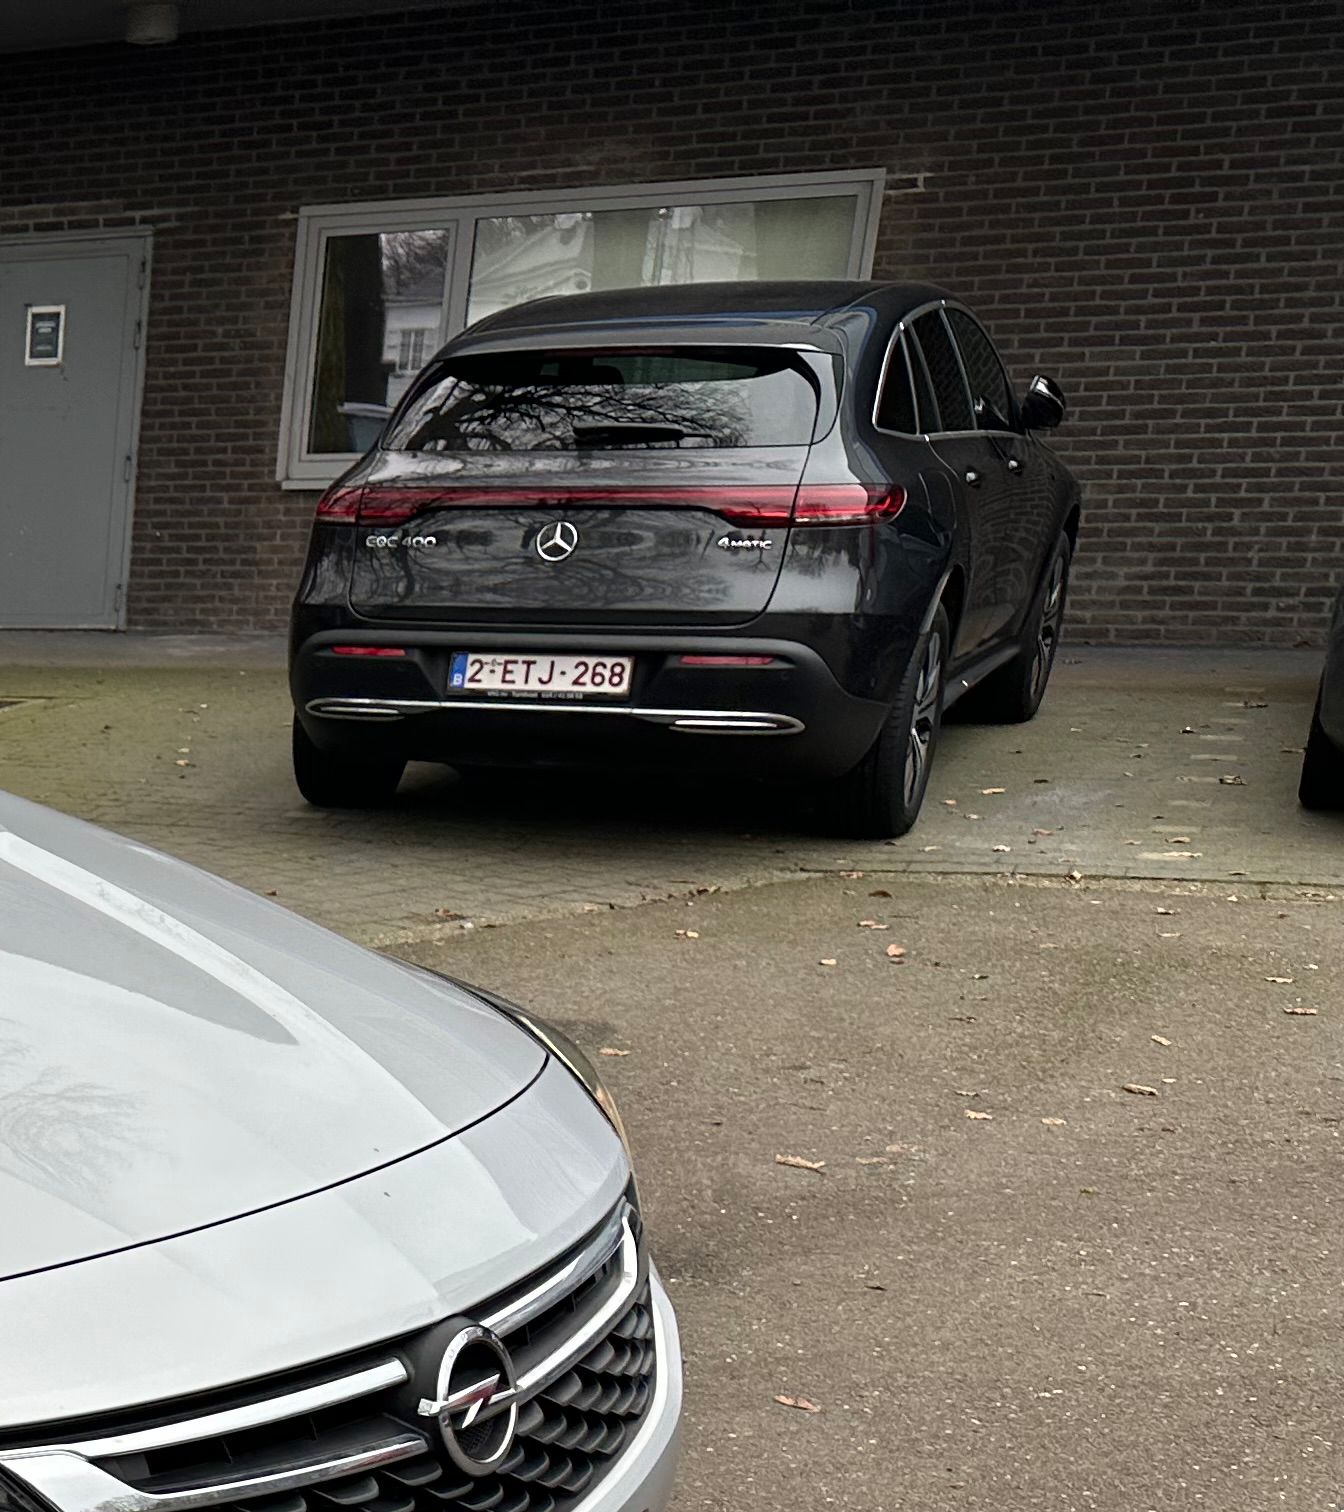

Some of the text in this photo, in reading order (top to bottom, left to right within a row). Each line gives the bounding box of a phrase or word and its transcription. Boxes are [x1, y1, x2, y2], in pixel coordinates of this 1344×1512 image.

[401, 536, 437, 548] 400
[452, 657, 626, 688] B 2-ETJ-268
